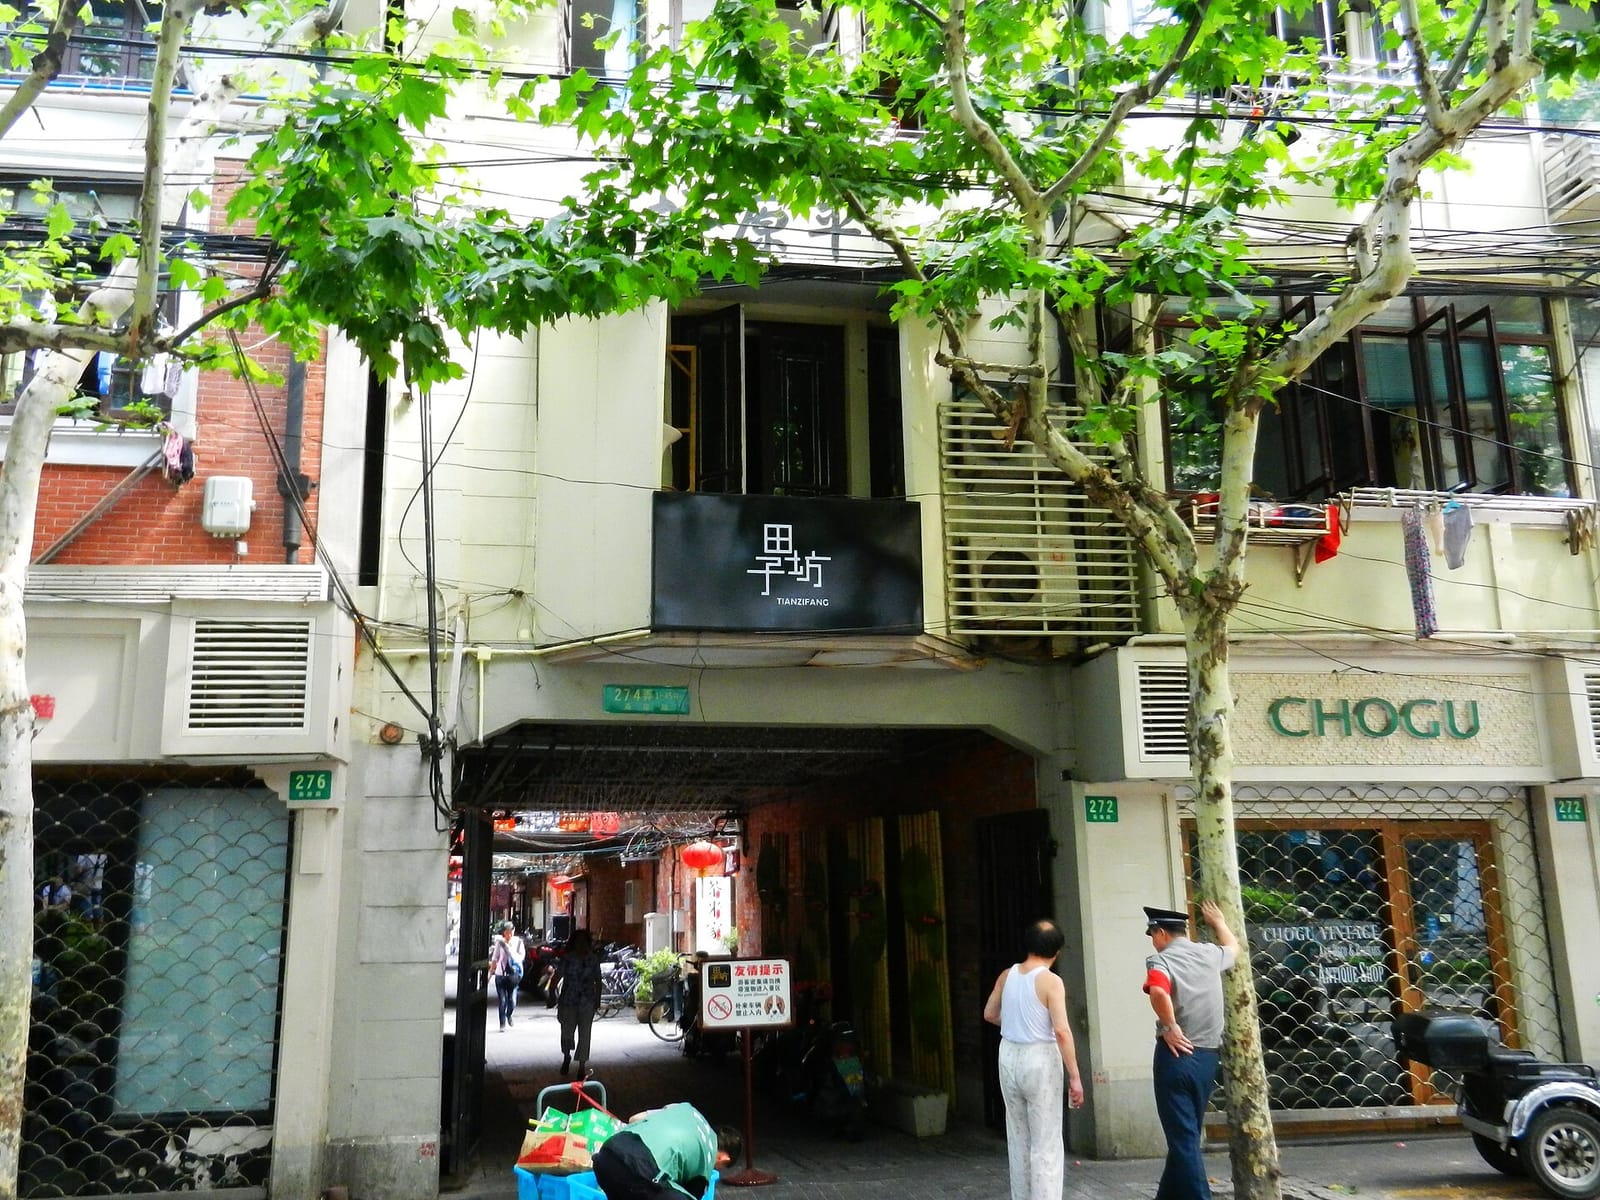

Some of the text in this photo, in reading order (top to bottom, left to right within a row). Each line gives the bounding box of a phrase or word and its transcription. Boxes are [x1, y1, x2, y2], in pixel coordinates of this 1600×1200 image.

[747, 523, 831, 596] 田子坊
[776, 597, 830, 607] TIANZIFANG
[1268, 696, 1481, 739] CHOGU
[295, 774, 326, 790] 276
[1089, 799, 1114, 813] 272
[1558, 800, 1582, 813] 272
[1318, 924, 1380, 940] VINTAGE
[735, 964, 783, 976] 友情提示
[1359, 962, 1384, 982] SHOP
[736, 1009, 762, 1017] 禁止入内
